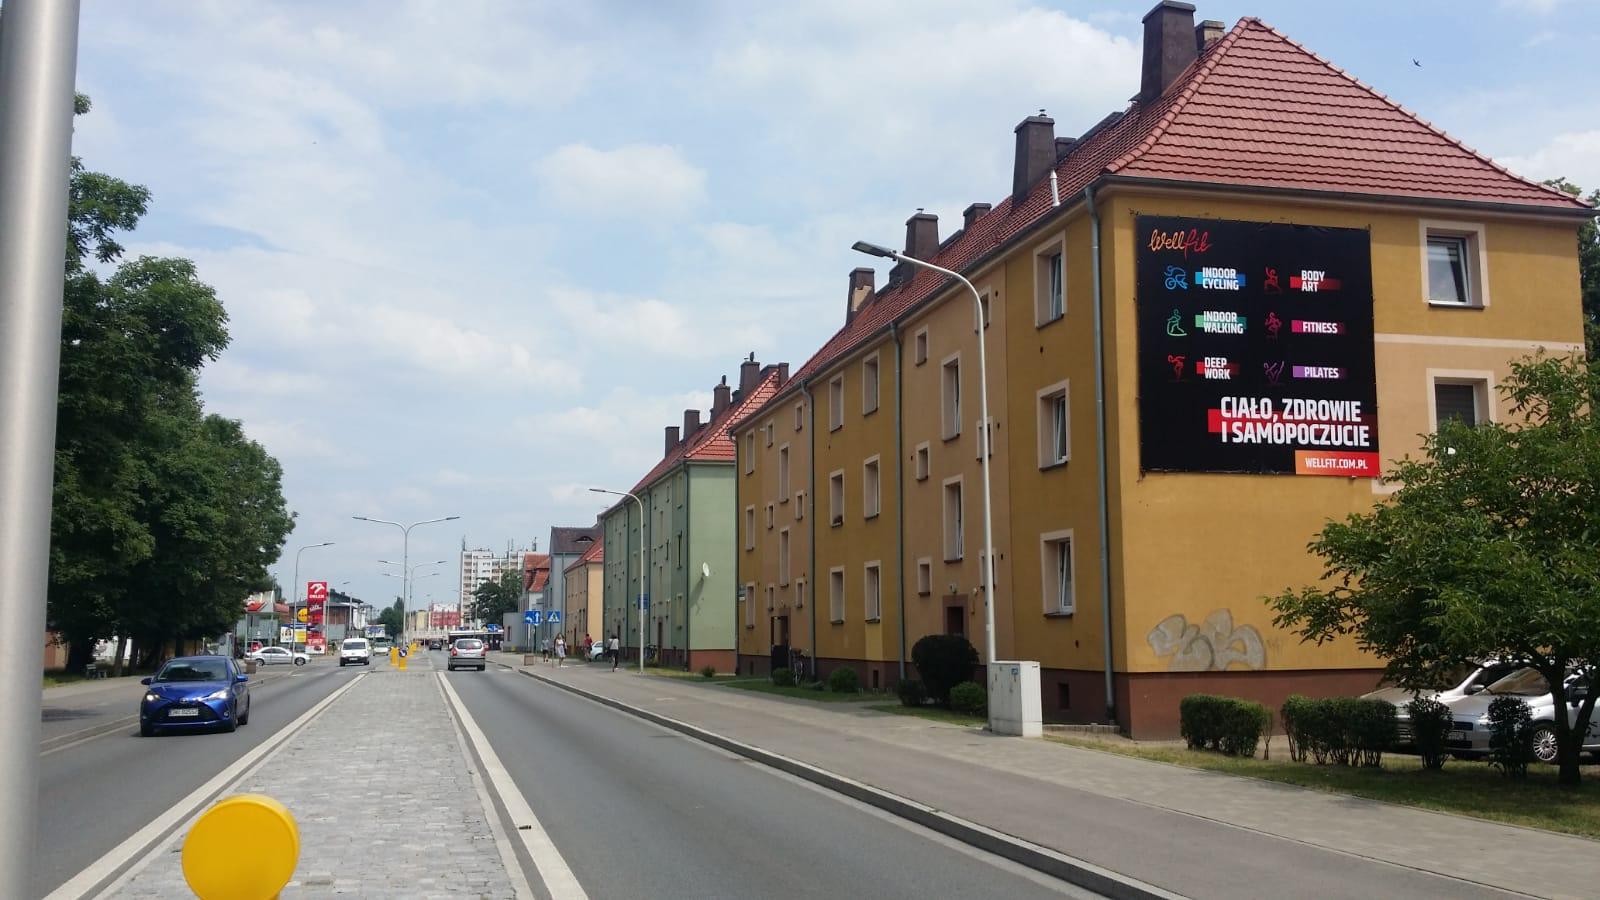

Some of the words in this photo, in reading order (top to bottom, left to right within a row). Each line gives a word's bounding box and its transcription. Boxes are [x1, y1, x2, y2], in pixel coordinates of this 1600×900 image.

[1202, 267, 1237, 279] INDOOR
[1301, 270, 1325, 281] BODY
[1202, 278, 1239, 290] CYCLING
[1301, 281, 1319, 292] ART
[1203, 311, 1237, 322] INDOOR
[1203, 322, 1243, 334] WALKING
[1302, 321, 1338, 334] FITNESS
[1204, 357, 1227, 368] DEEP
[1204, 368, 1231, 380] WORK
[1304, 367, 1339, 379] PILATES
[1220, 396, 1278, 424] CIAŁO,
[1282, 398, 1362, 422] ZDROWIE
[1222, 422, 1227, 443] I
[1232, 421, 1370, 446] SAMOPOCZUCIE
[1305, 457, 1368, 470] WELLFIT.COM.PL
